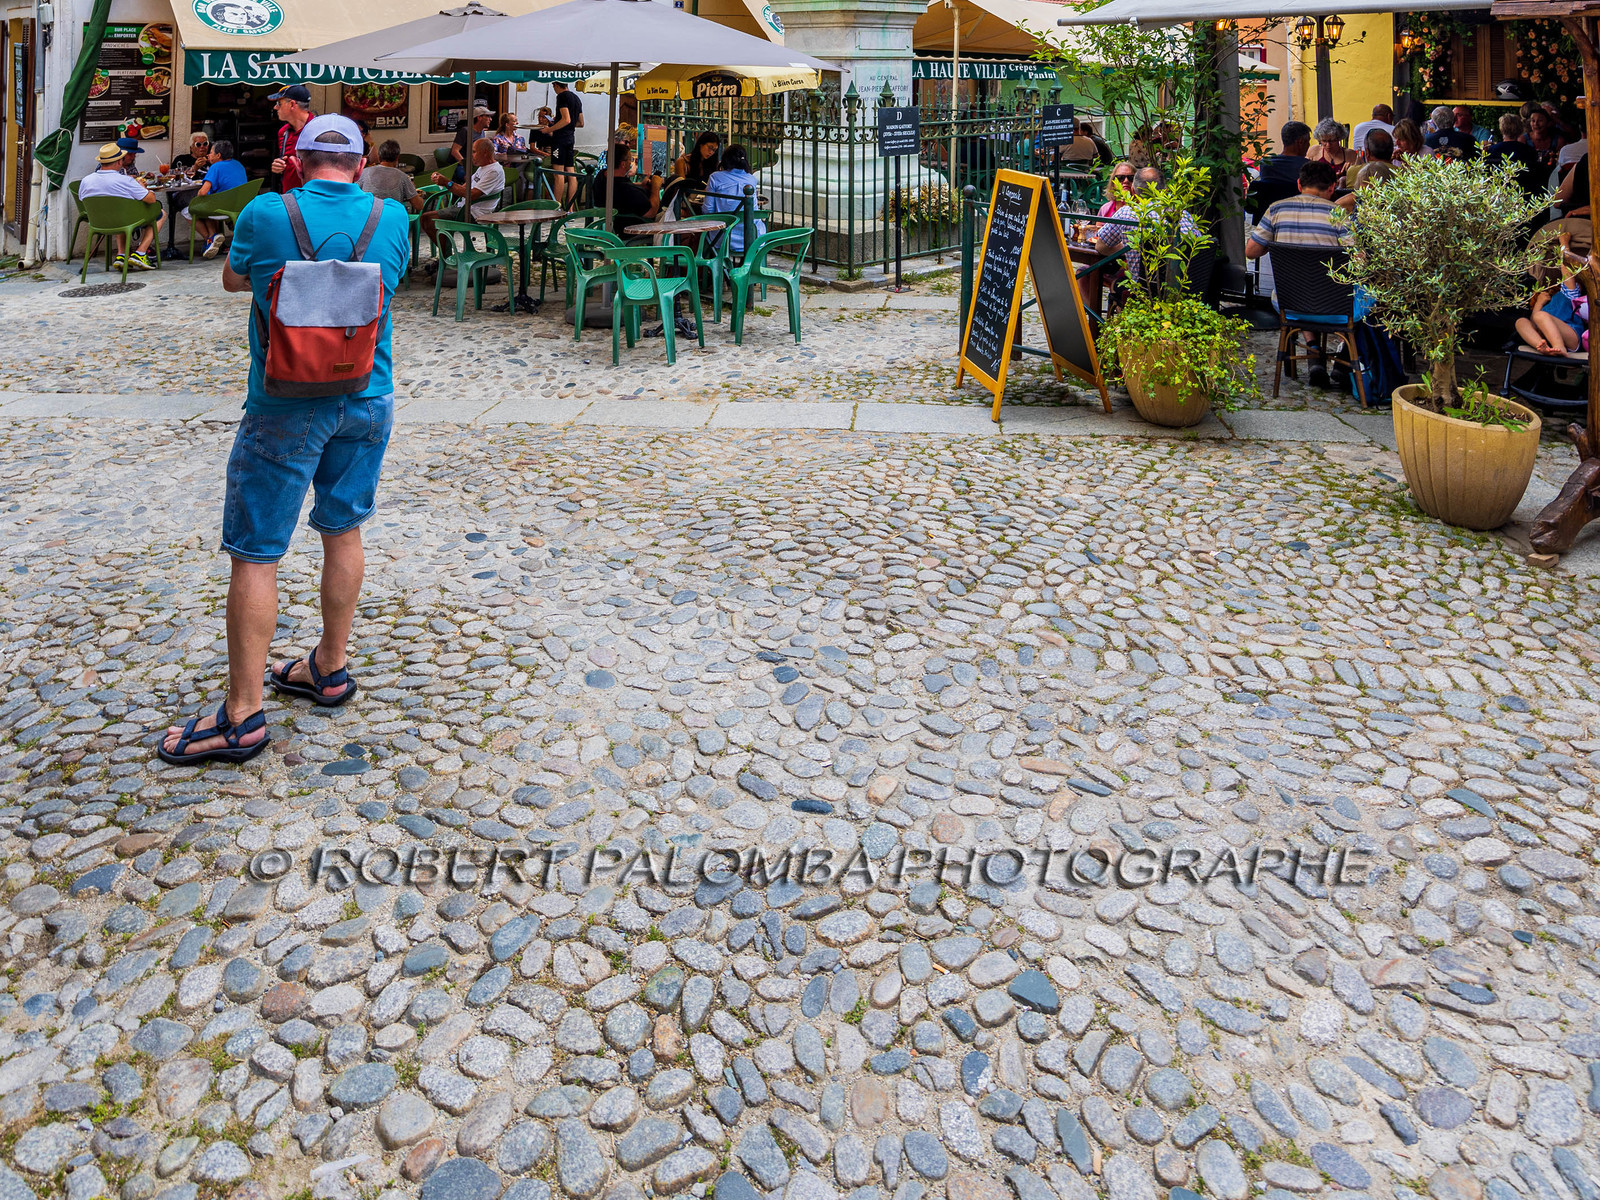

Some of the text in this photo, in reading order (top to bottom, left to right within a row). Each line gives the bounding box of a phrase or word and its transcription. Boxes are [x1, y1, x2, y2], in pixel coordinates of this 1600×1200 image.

[260, 0, 279, 13] VILLE
[211, 23, 238, 33] PLACE
[200, 52, 454, 79] LA SANDWIC
[1008, 63, 1037, 72] Crêpes
[973, 63, 1008, 79] VILLE
[1028, 71, 1057, 79] Panini
[696, 82, 738, 98] Pietra
[896, 111, 903, 121] D
[1056, 107, 1062, 117] C
[376, 116, 406, 125] BHV
